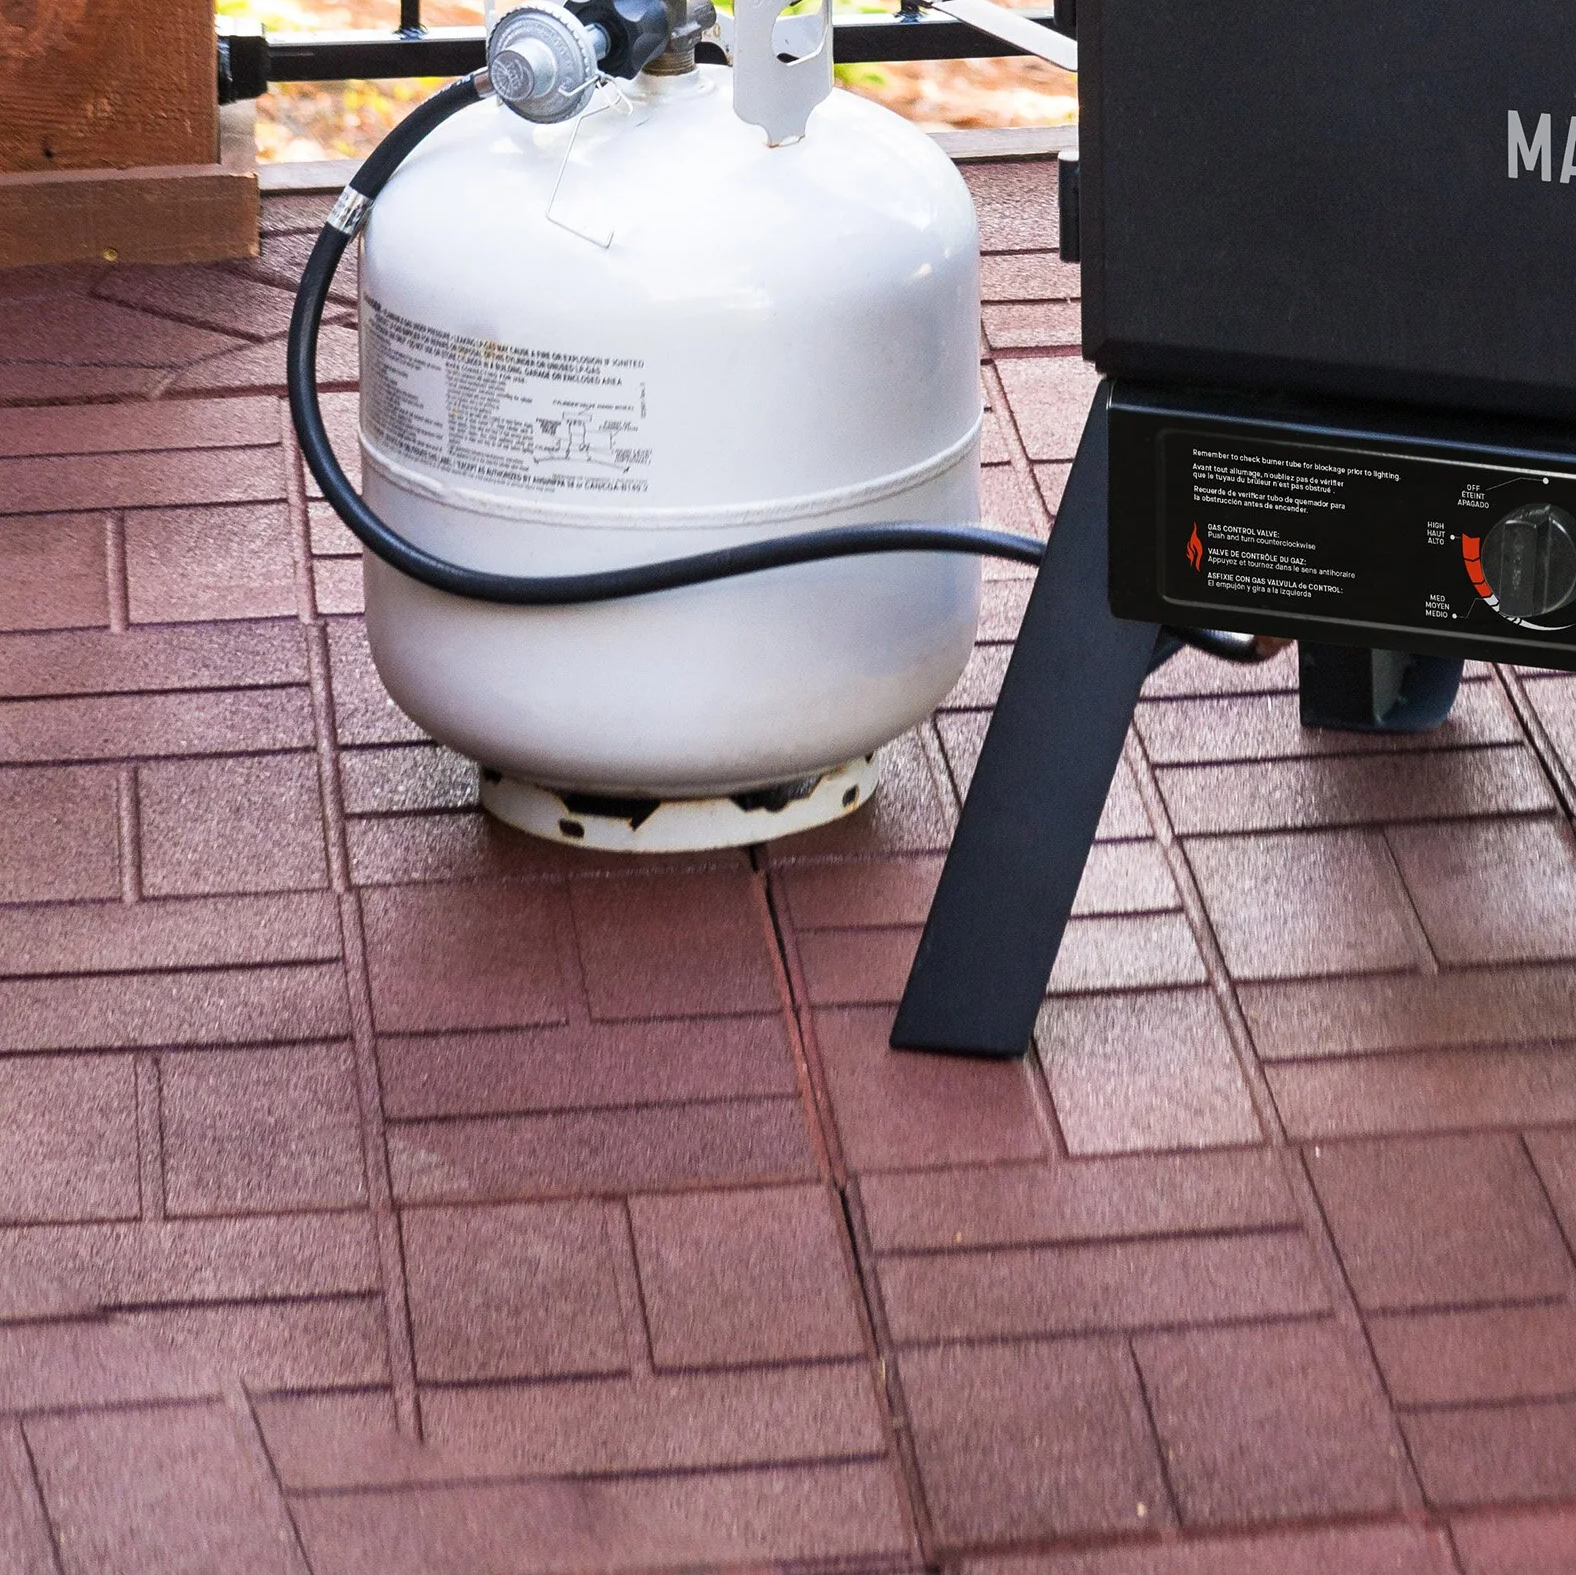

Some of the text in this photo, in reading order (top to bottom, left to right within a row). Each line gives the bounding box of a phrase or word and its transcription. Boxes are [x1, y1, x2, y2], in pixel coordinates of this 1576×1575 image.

[1193, 449, 1229, 460] Remember
[1231, 453, 1238, 461] to
[1240, 455, 1260, 463] check
[1262, 457, 1284, 466] burner
[1286, 459, 1302, 468] tube
[1303, 461, 1313, 470] for
[1314, 463, 1345, 475] blockage
[1347, 468, 1363, 476] prior
[1364, 468, 1372, 476] to
[1193, 463, 1212, 471] Avant
[1214, 465, 1227, 473] tout
[1296, 476, 1308, 484] pas
[1310, 476, 1318, 484] de
[1193, 471, 1206, 479] que
[1216, 473, 1234, 482] tuyau
[1236, 475, 1245, 483] du
[1467, 484, 1480, 492] OFF
[1194, 485, 1346, 510] Recuerde de verificar tubo de quemador para
[1194, 493, 1200, 501] la
[1244, 500, 1263, 508] antes
[1457, 499, 1489, 509] APAGADO
[1207, 523, 1280, 538] GAS CONTROL VALVE:
[1427, 521, 1445, 530] HIGH
[1208, 531, 1225, 539] Push
[1241, 534, 1255, 543] turn
[1256, 537, 1316, 549] counterclockwise
[1427, 529, 1446, 538] HAUT
[1427, 537, 1445, 545] ALTO
[1208, 547, 1229, 556] VALVE
[1230, 550, 1240, 558] DE
[1290, 557, 1307, 565] GAZ:
[1207, 555, 1237, 566] Appuyez
[1247, 560, 1274, 569] tournez
[1275, 563, 1292, 571] dans
[1207, 572, 1234, 581] ASFIXIE
[1235, 575, 1250, 583] CON
[1251, 577, 1266, 585] GAS
[1266, 579, 1297, 588] VALVULA
[1308, 583, 1343, 593] CONTROL:
[1246, 585, 1251, 593] y
[1251, 585, 1266, 593] gira
[1280, 588, 1312, 598] izquierda
[1430, 594, 1446, 602] MED
[1425, 601, 1450, 610] MOYEN
[1425, 609, 1448, 618] MEDIO
